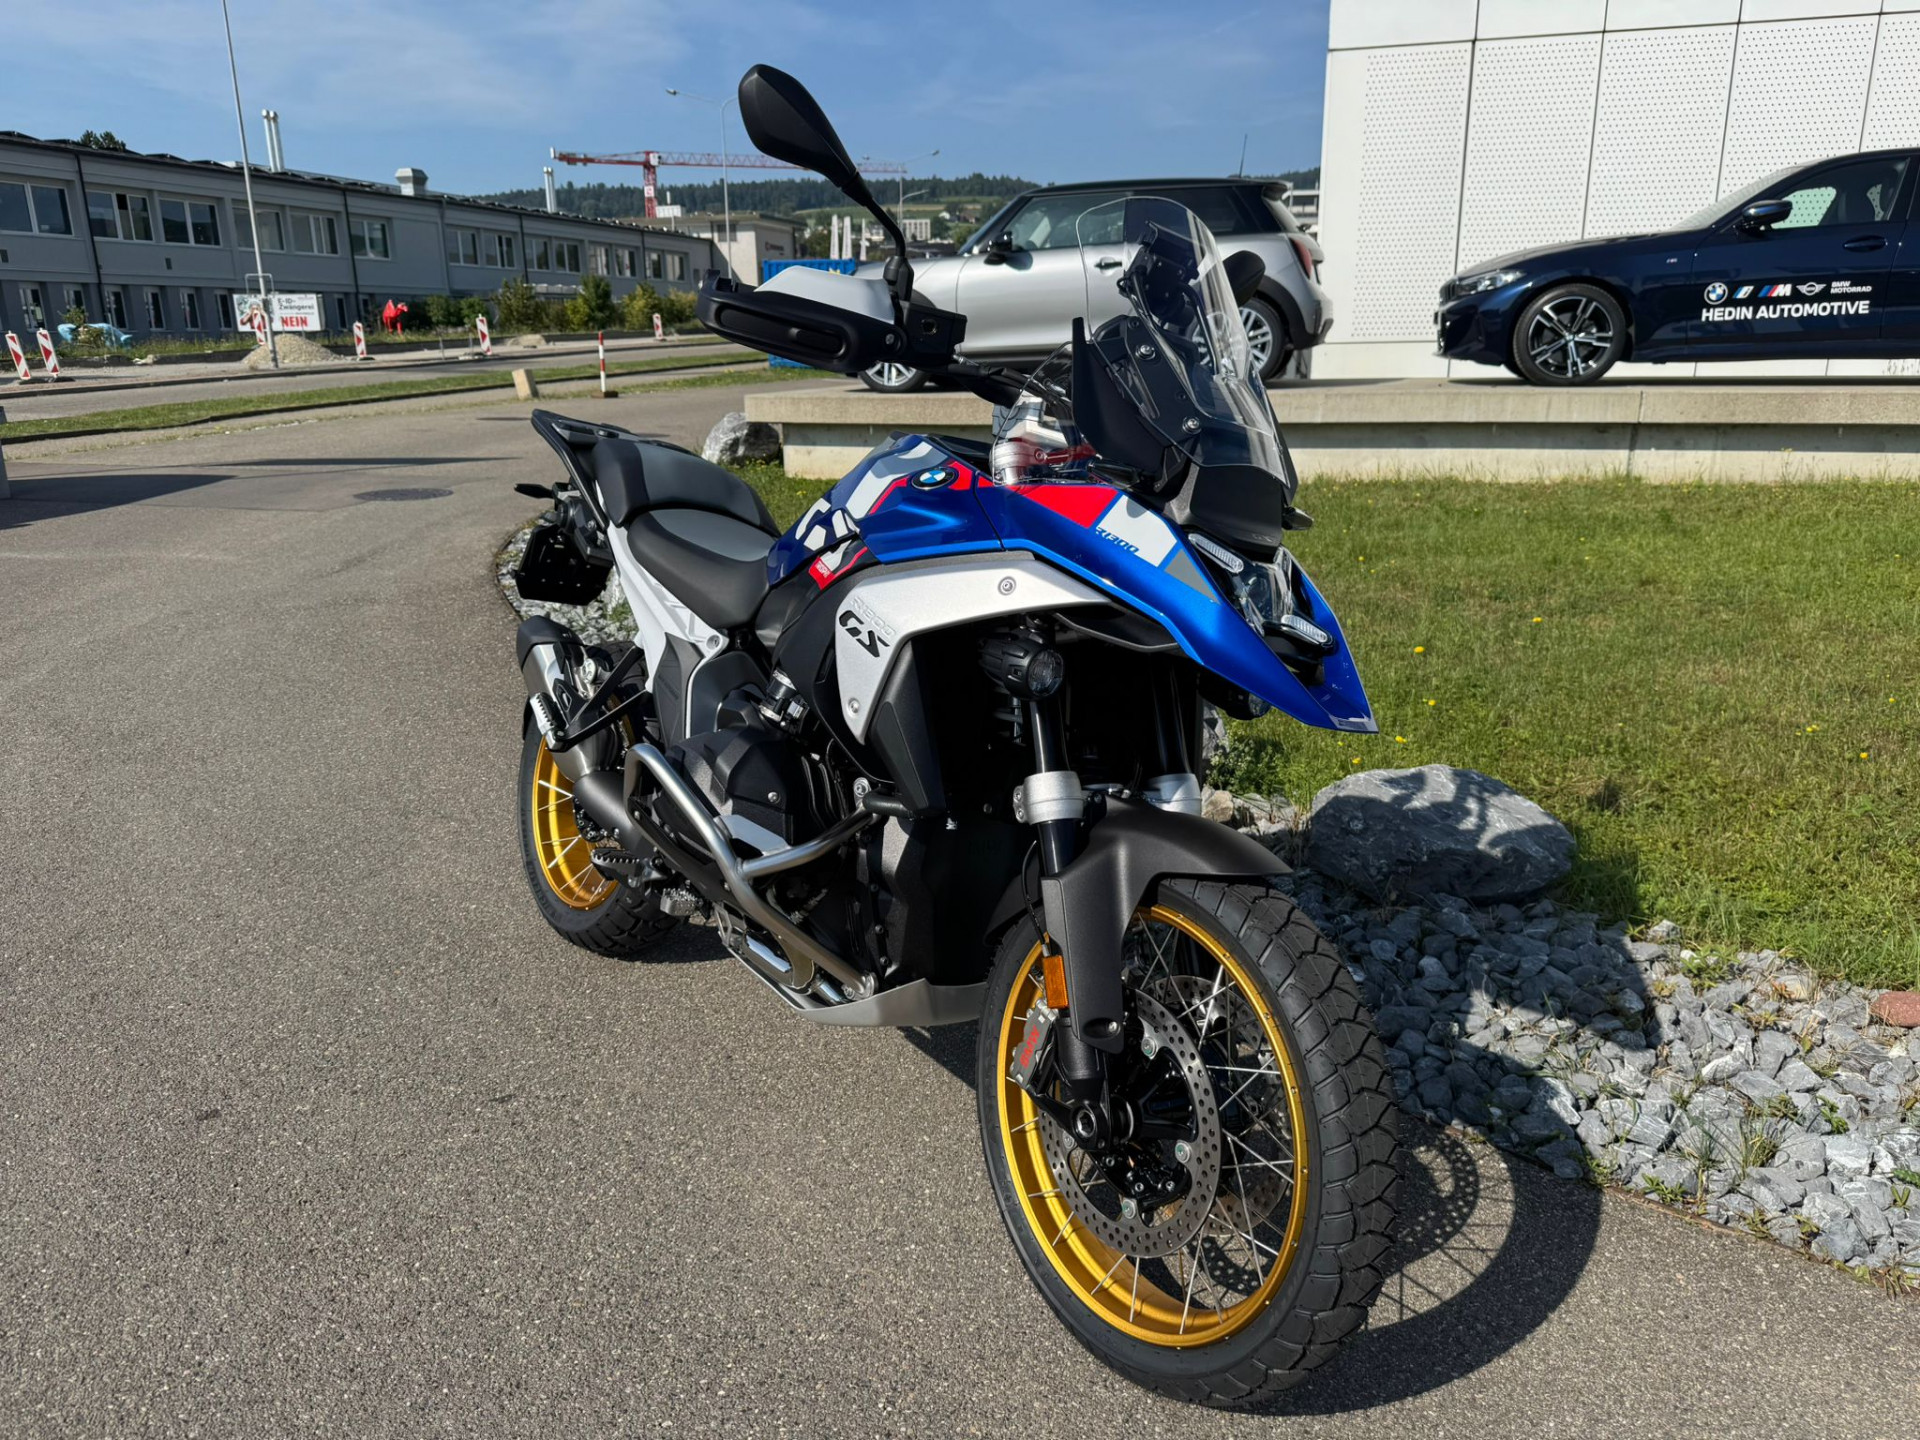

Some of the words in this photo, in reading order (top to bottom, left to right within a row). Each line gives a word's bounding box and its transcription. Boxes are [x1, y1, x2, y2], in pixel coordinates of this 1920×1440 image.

[1830, 286, 1872, 294] MOTORRAD
[1701, 305, 1754, 322] HEDIN
[1755, 300, 1870, 319] AUTOMOTIVE
[280, 316, 308, 327] NEIN
[838, 610, 891, 658] GS
